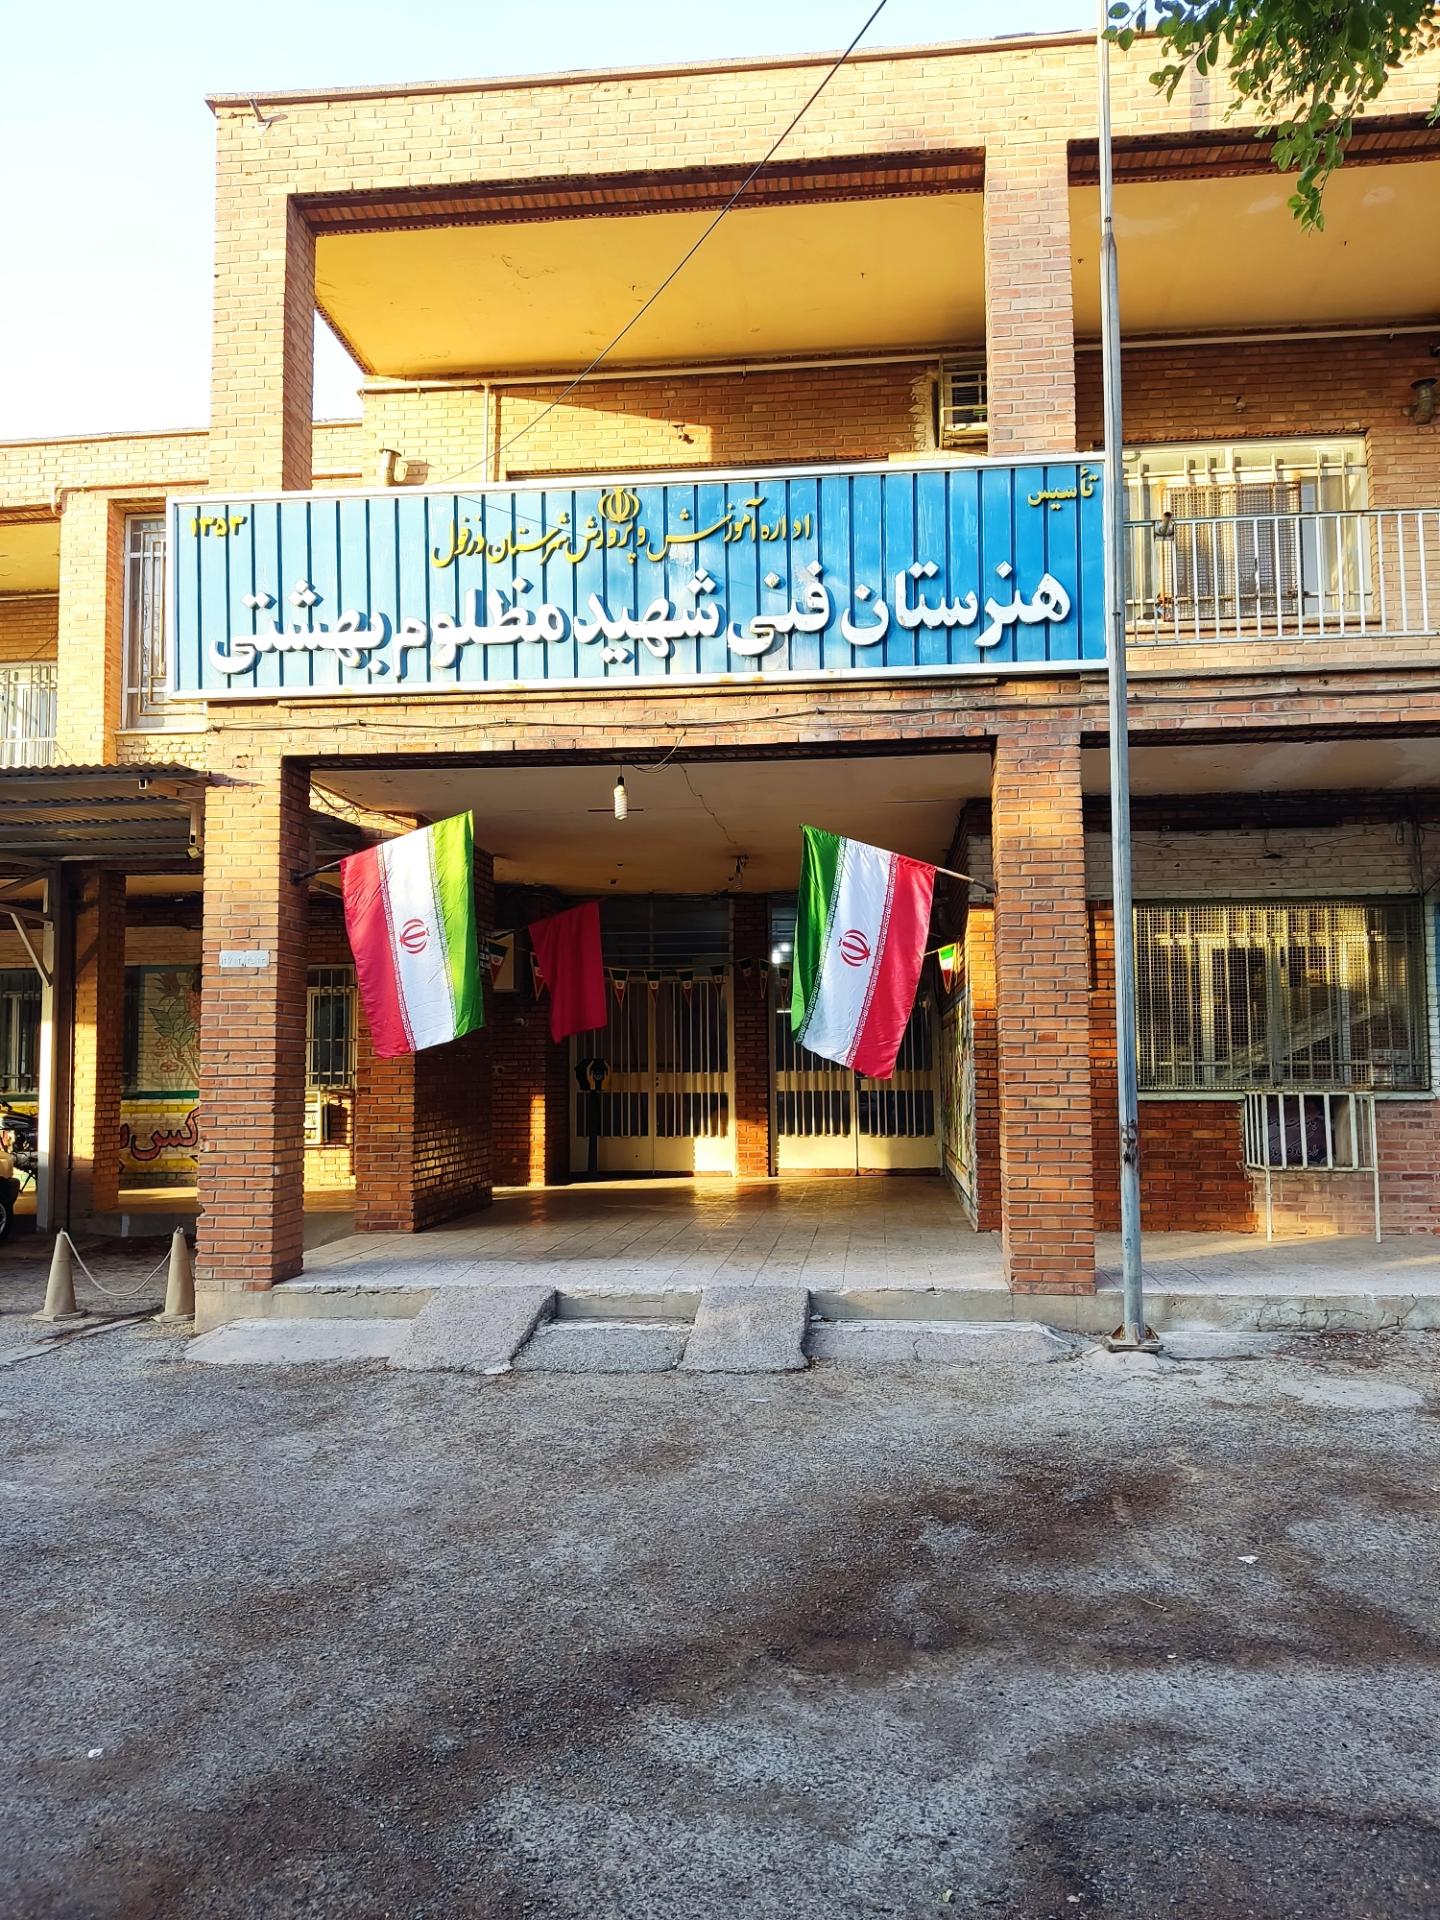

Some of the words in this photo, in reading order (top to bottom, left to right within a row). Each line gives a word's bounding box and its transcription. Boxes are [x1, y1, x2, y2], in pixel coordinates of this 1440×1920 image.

[1028, 465, 1099, 510] تأسیس
[191, 515, 246, 537] ۱۳۵۳
[432, 514, 487, 569] دزفول
[486, 511, 571, 566] شهرستان
[564, 515, 637, 565] پرورش
[636, 525, 646, 547] و
[646, 496, 766, 563] آموزش
[760, 512, 811, 541] اداره
[208, 579, 386, 674] بهشتی
[394, 576, 567, 677] مظلوم
[573, 567, 720, 664] شهید
[727, 559, 831, 657] فنی
[840, 560, 1071, 649] هنرستان
